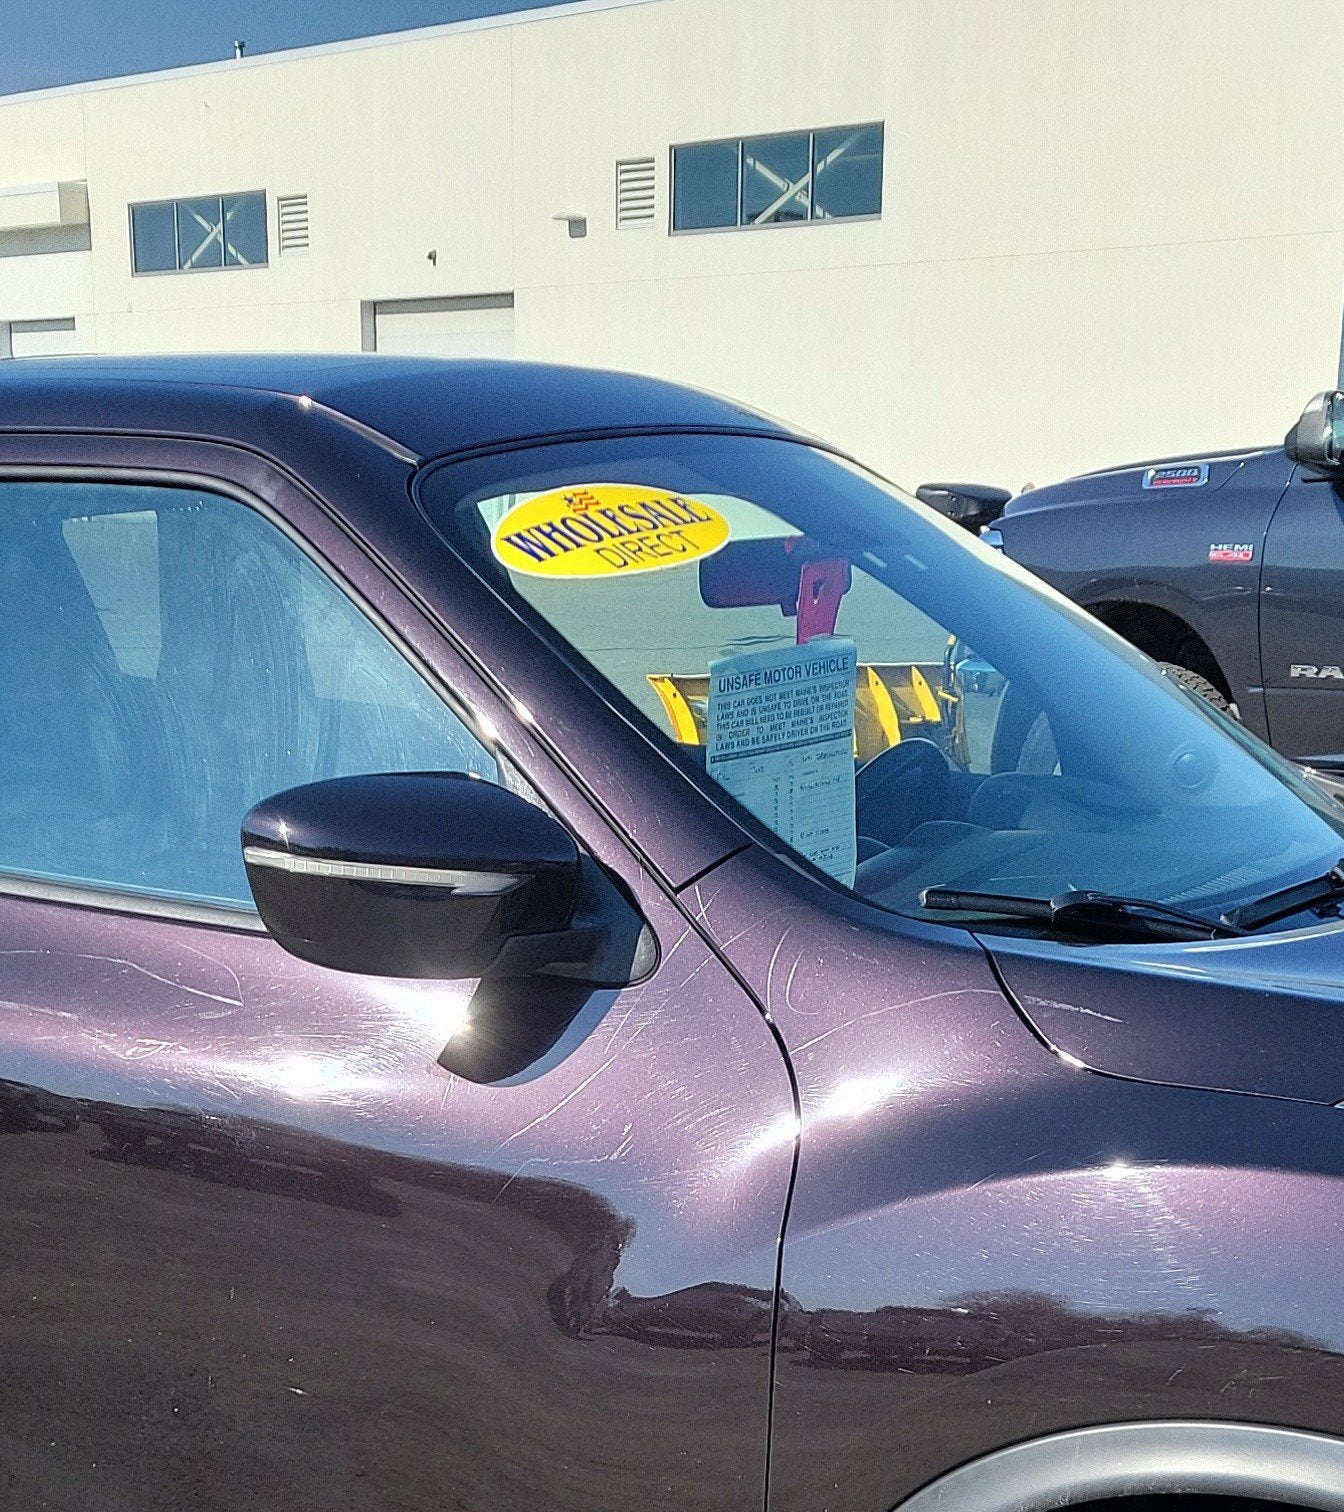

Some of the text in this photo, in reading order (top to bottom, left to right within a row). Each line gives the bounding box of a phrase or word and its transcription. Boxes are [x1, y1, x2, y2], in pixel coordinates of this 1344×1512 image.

[500, 496, 712, 563] WHOLESALE
[1209, 543, 1254, 552] HEMI
[595, 530, 701, 569] DIRECT
[718, 657, 849, 693] UNSAFE MOTOR VEHICLE
